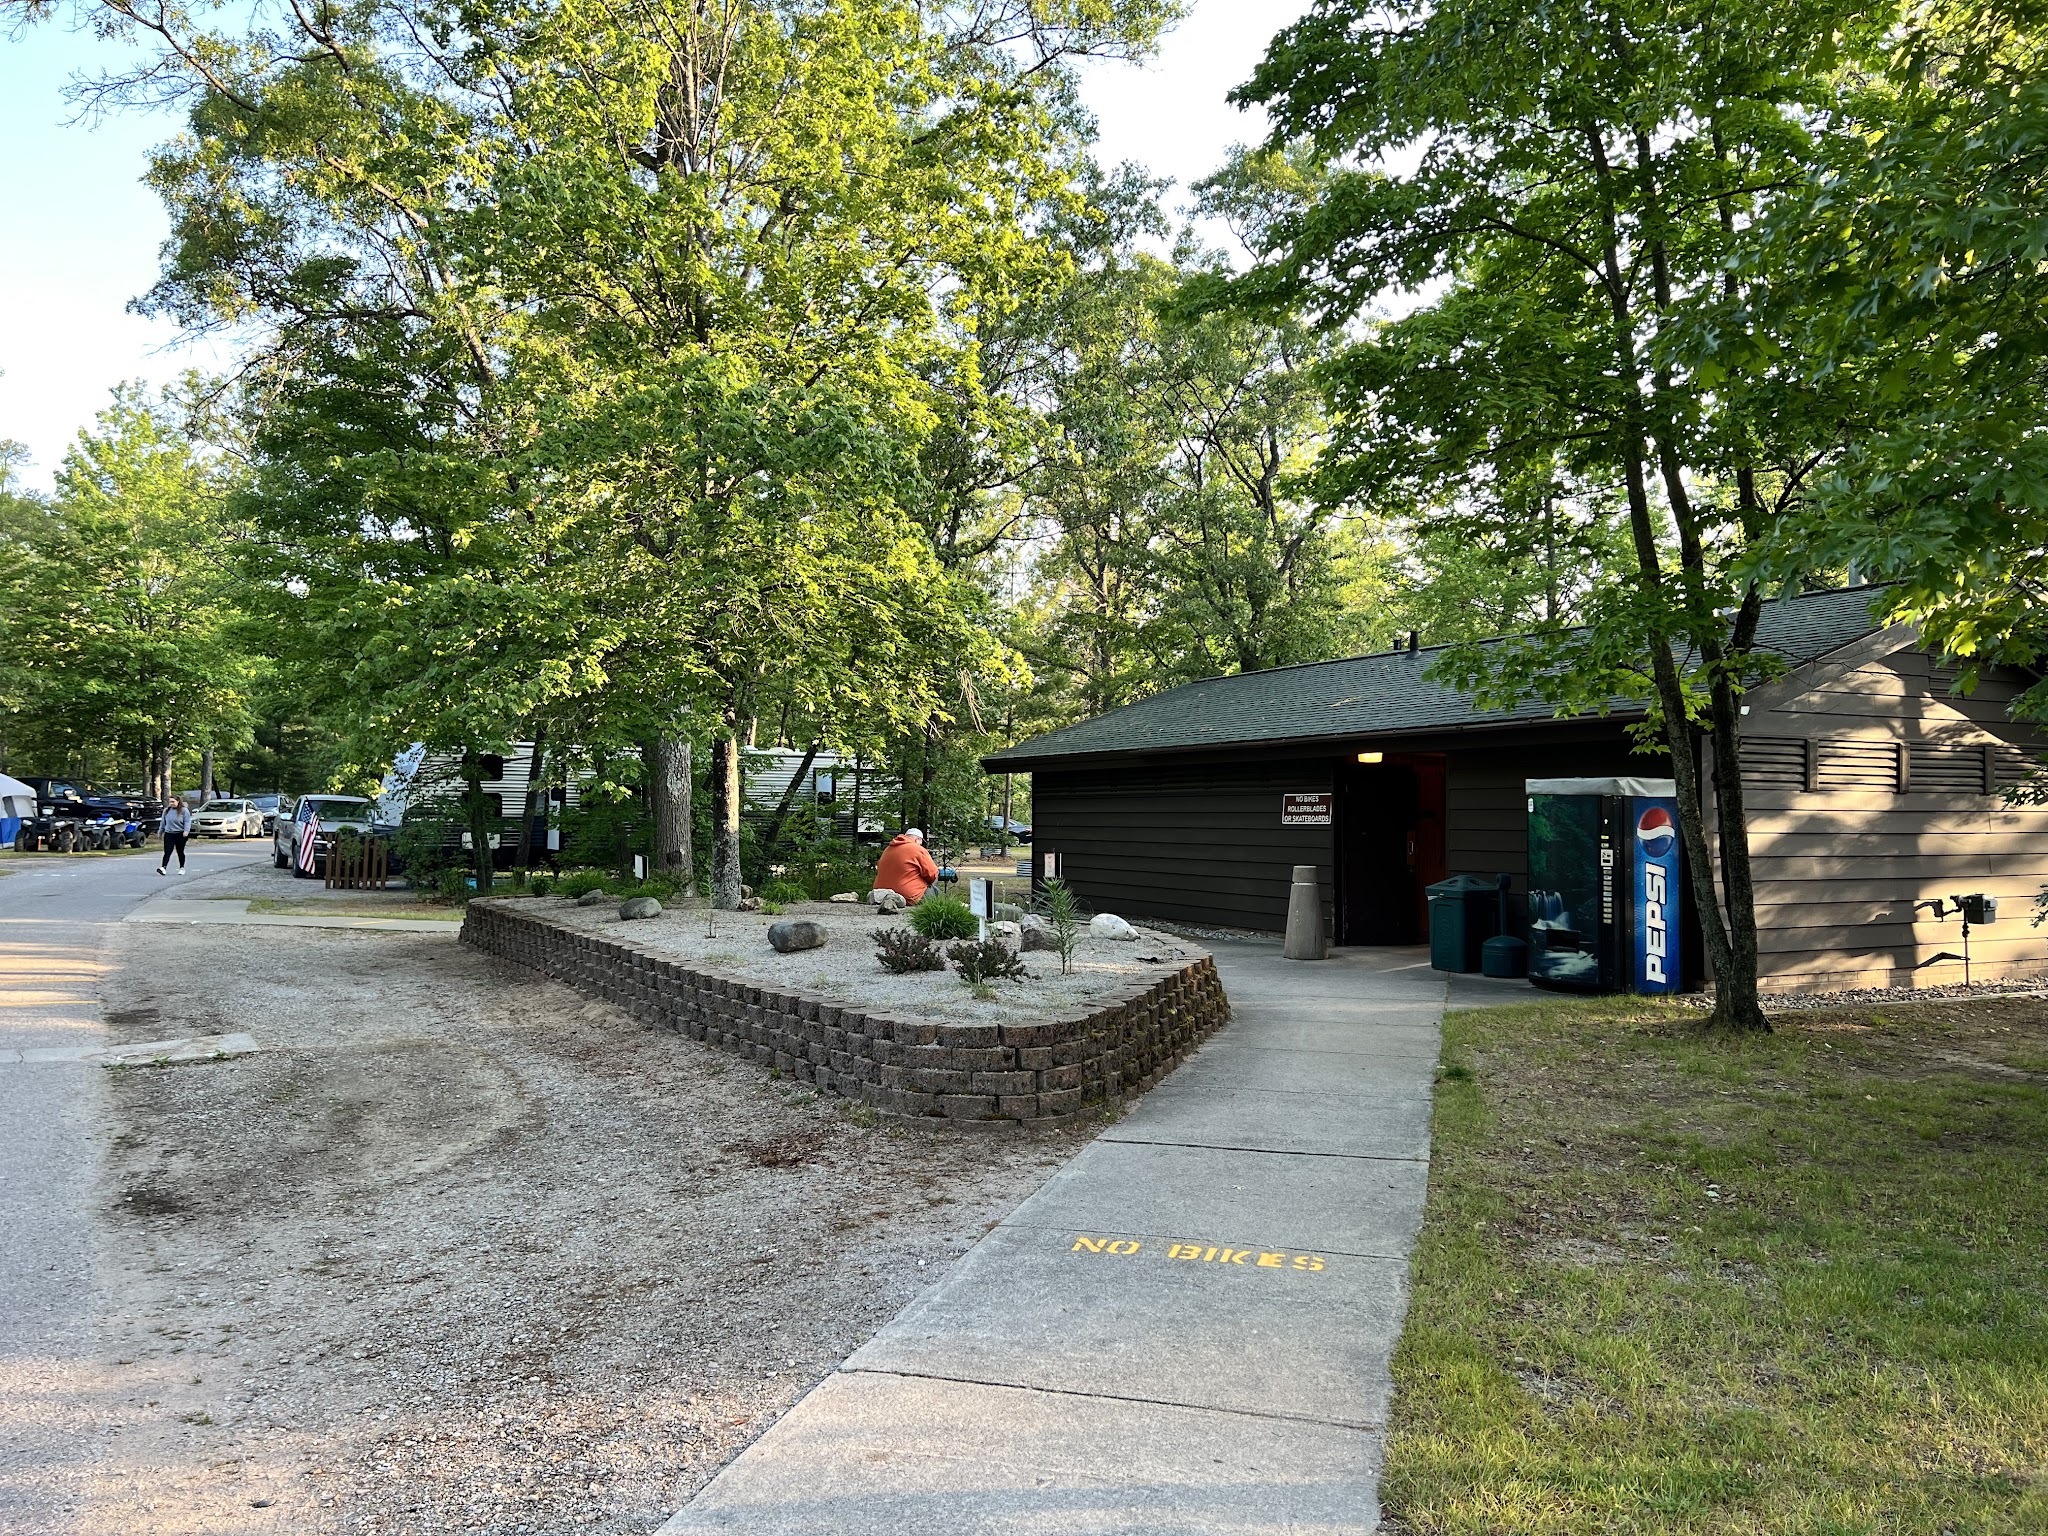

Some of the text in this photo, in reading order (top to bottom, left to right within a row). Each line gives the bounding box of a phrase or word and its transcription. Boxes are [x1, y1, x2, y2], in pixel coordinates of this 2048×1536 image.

[1645, 862, 1667, 984] PEPSI
[1071, 1237, 1325, 1271] NO BIKES
